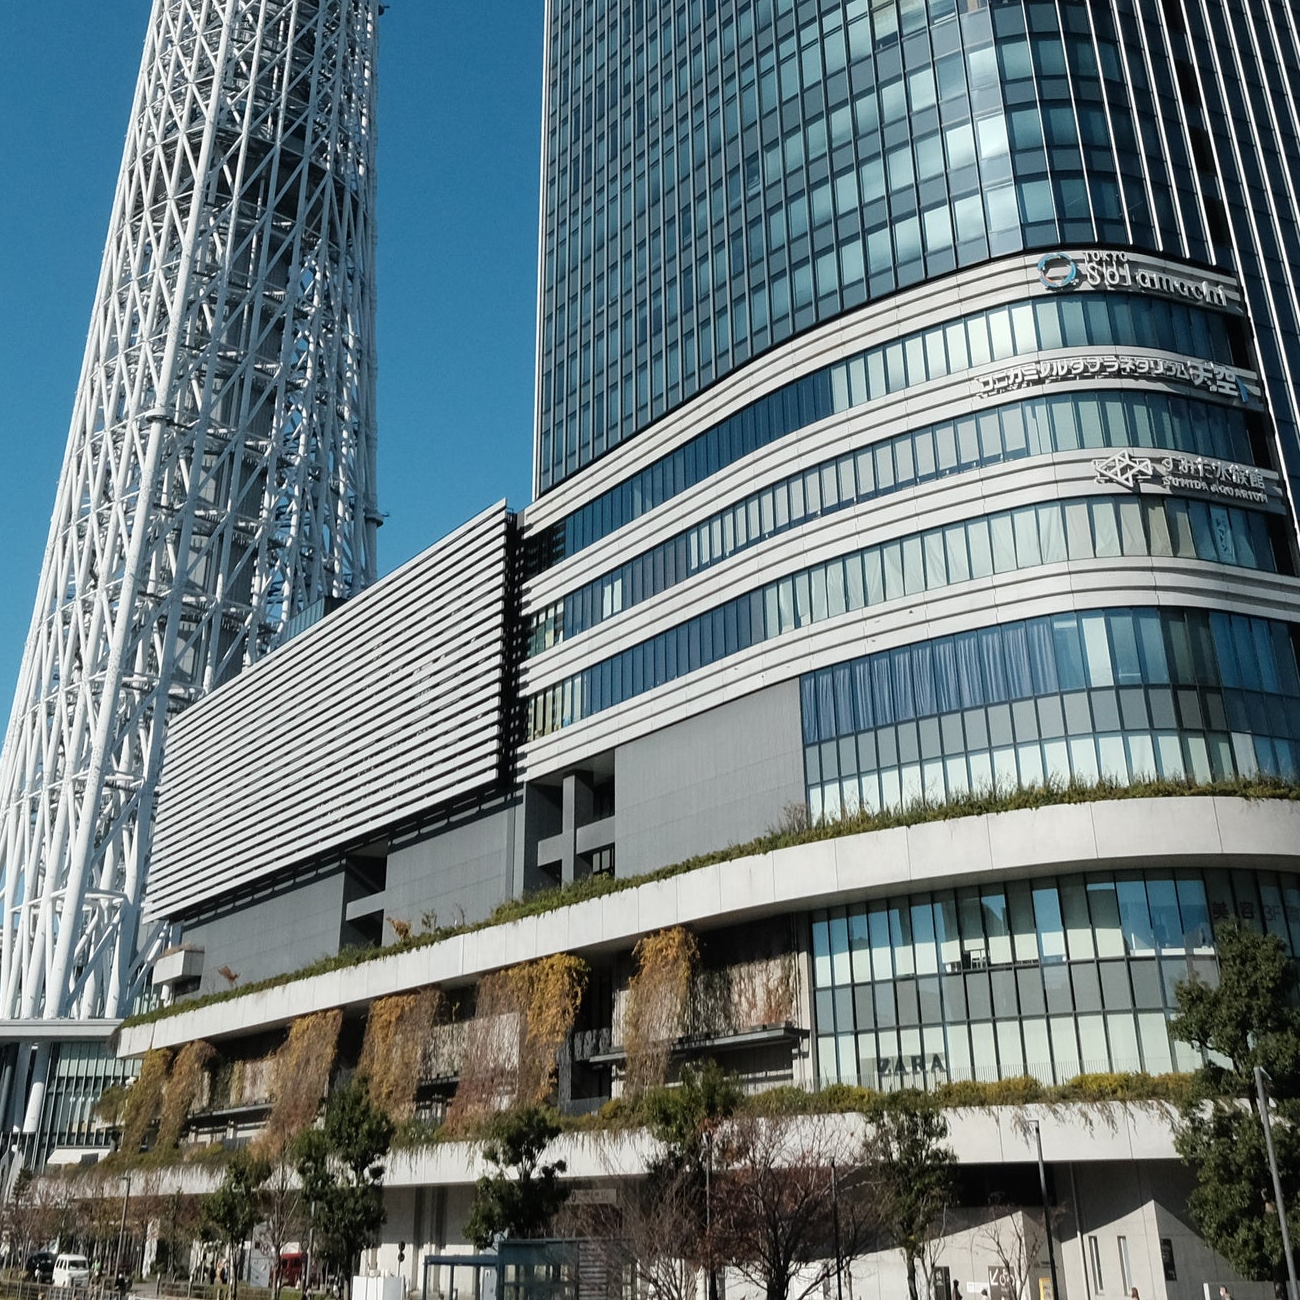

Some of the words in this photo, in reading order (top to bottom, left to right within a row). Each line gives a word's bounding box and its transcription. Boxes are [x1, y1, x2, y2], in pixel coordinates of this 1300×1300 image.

[1083, 251, 1129, 263] TOKYO
[1162, 476, 1210, 493] SUMIDA
[877, 1053, 947, 1077] ZARA
